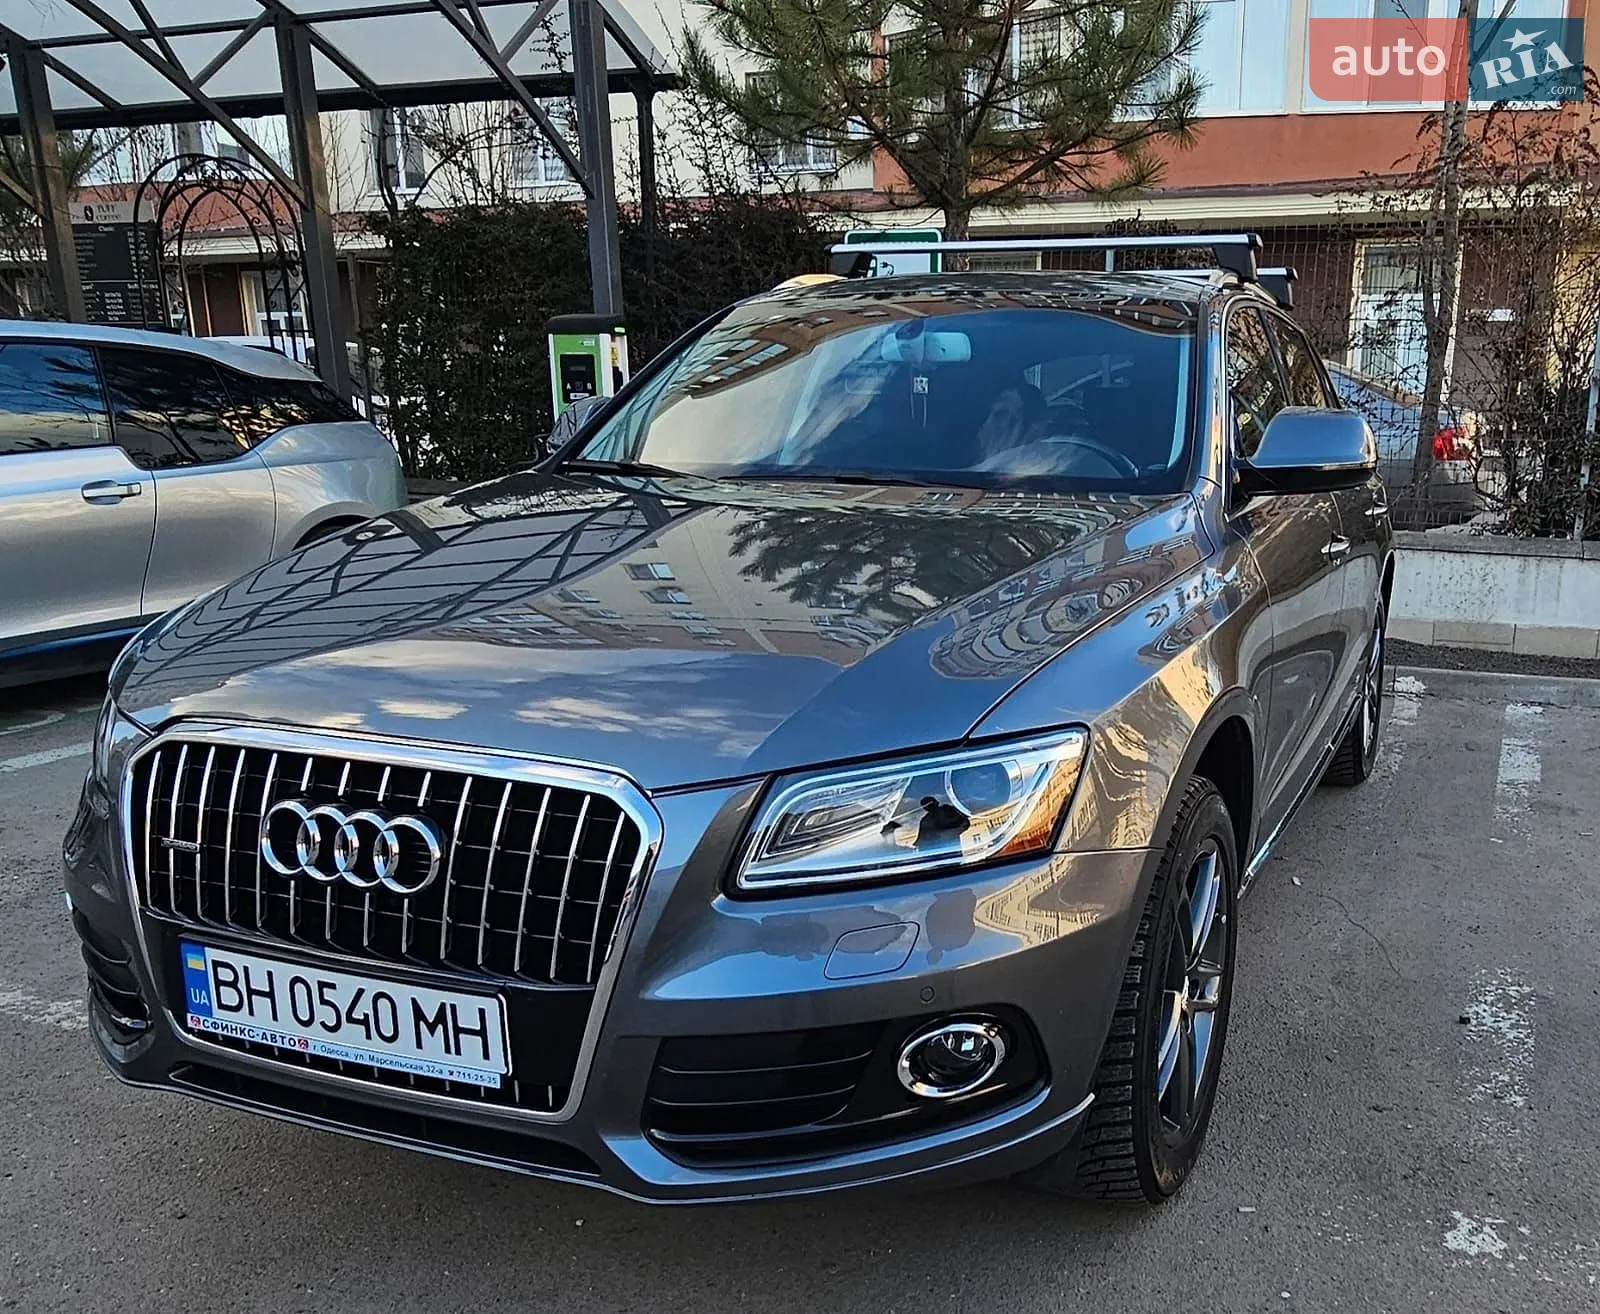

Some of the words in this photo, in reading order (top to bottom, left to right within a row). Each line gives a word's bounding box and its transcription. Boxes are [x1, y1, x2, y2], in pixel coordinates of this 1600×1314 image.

[191, 987, 209, 1008] UA
[289, 975, 400, 1044] 0540
[202, 1018, 297, 1047] СФИНКС-АВТО
